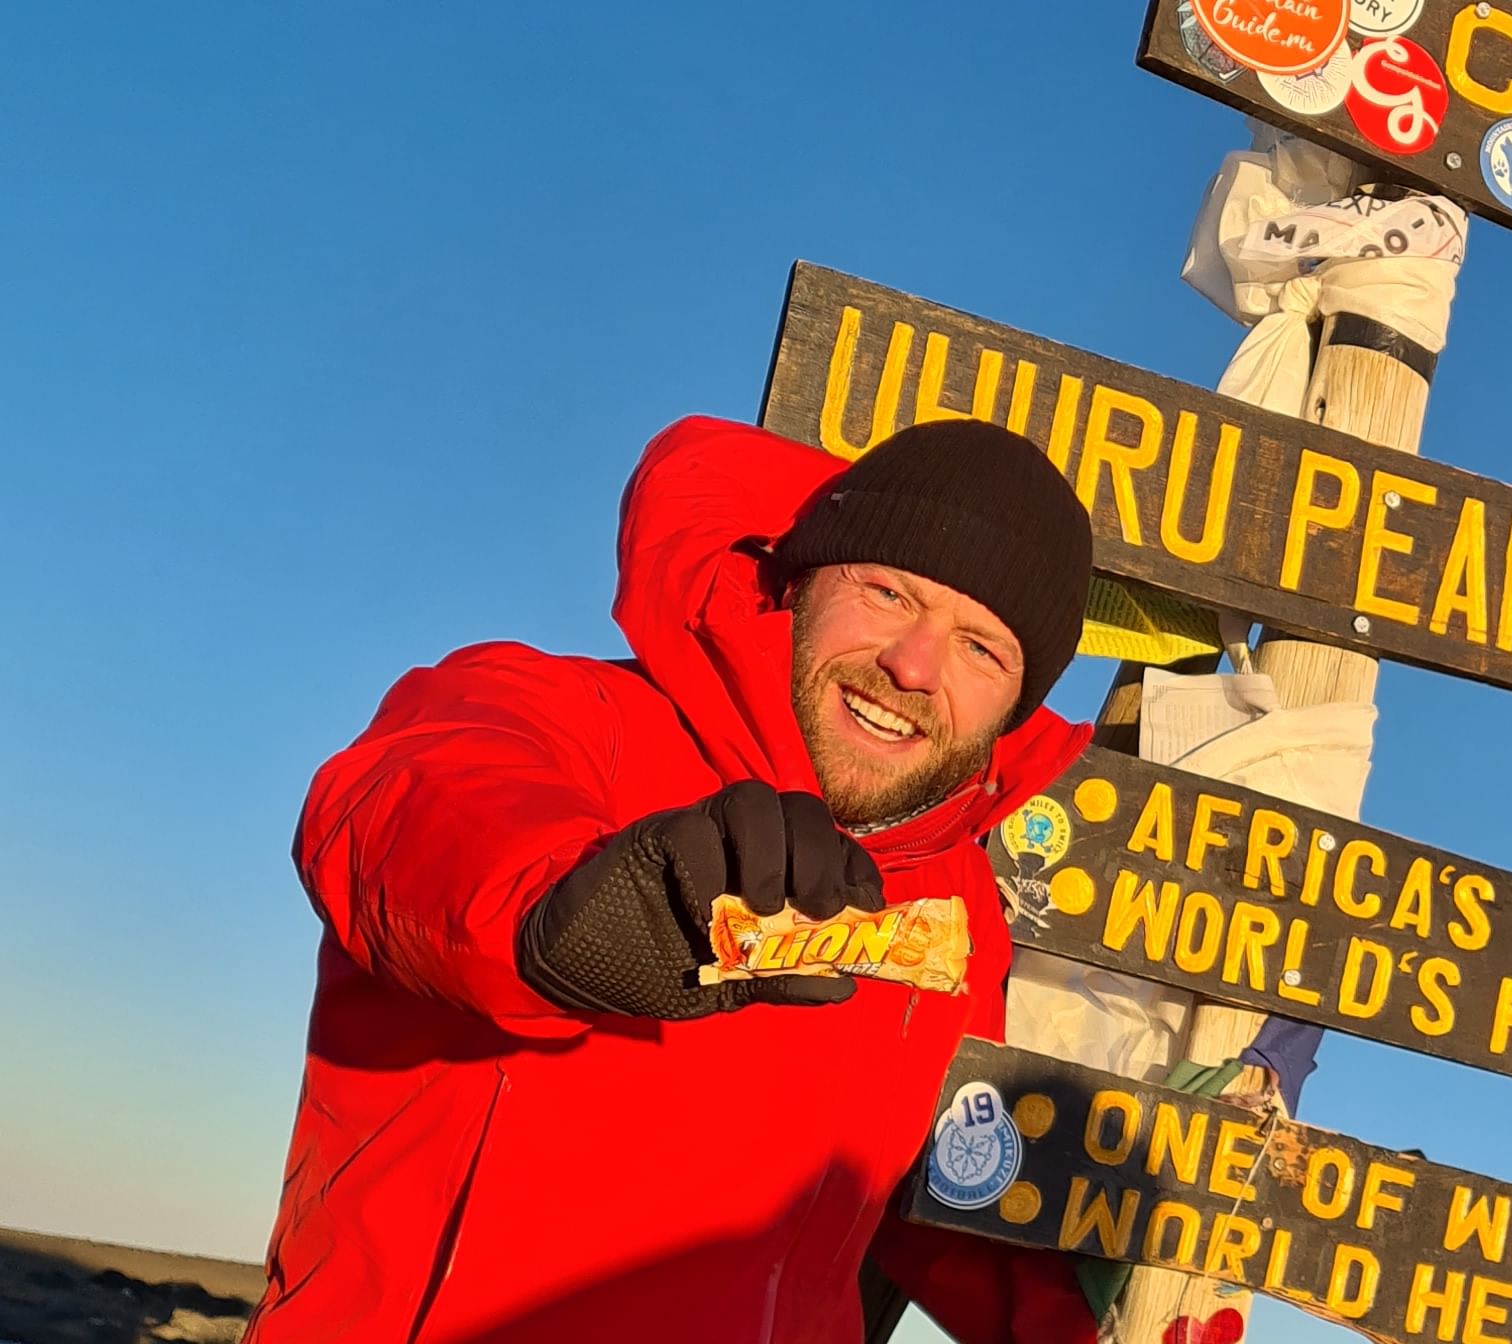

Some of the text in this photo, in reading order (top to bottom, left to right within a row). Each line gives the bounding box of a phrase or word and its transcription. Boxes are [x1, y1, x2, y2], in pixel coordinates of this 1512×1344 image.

[818, 306, 1244, 566] UHURU
[1030, 799, 1055, 813] MILES
[1055, 813, 1066, 826] TO
[1125, 781, 1496, 954] AFRICA'S
[1099, 867, 1461, 1039] WORLD'S
[961, 1092, 995, 1128] 19
[1085, 1087, 1267, 1205] ONE
[1299, 1144, 1416, 1232] OF
[1059, 1175, 1380, 1321] WORLD
